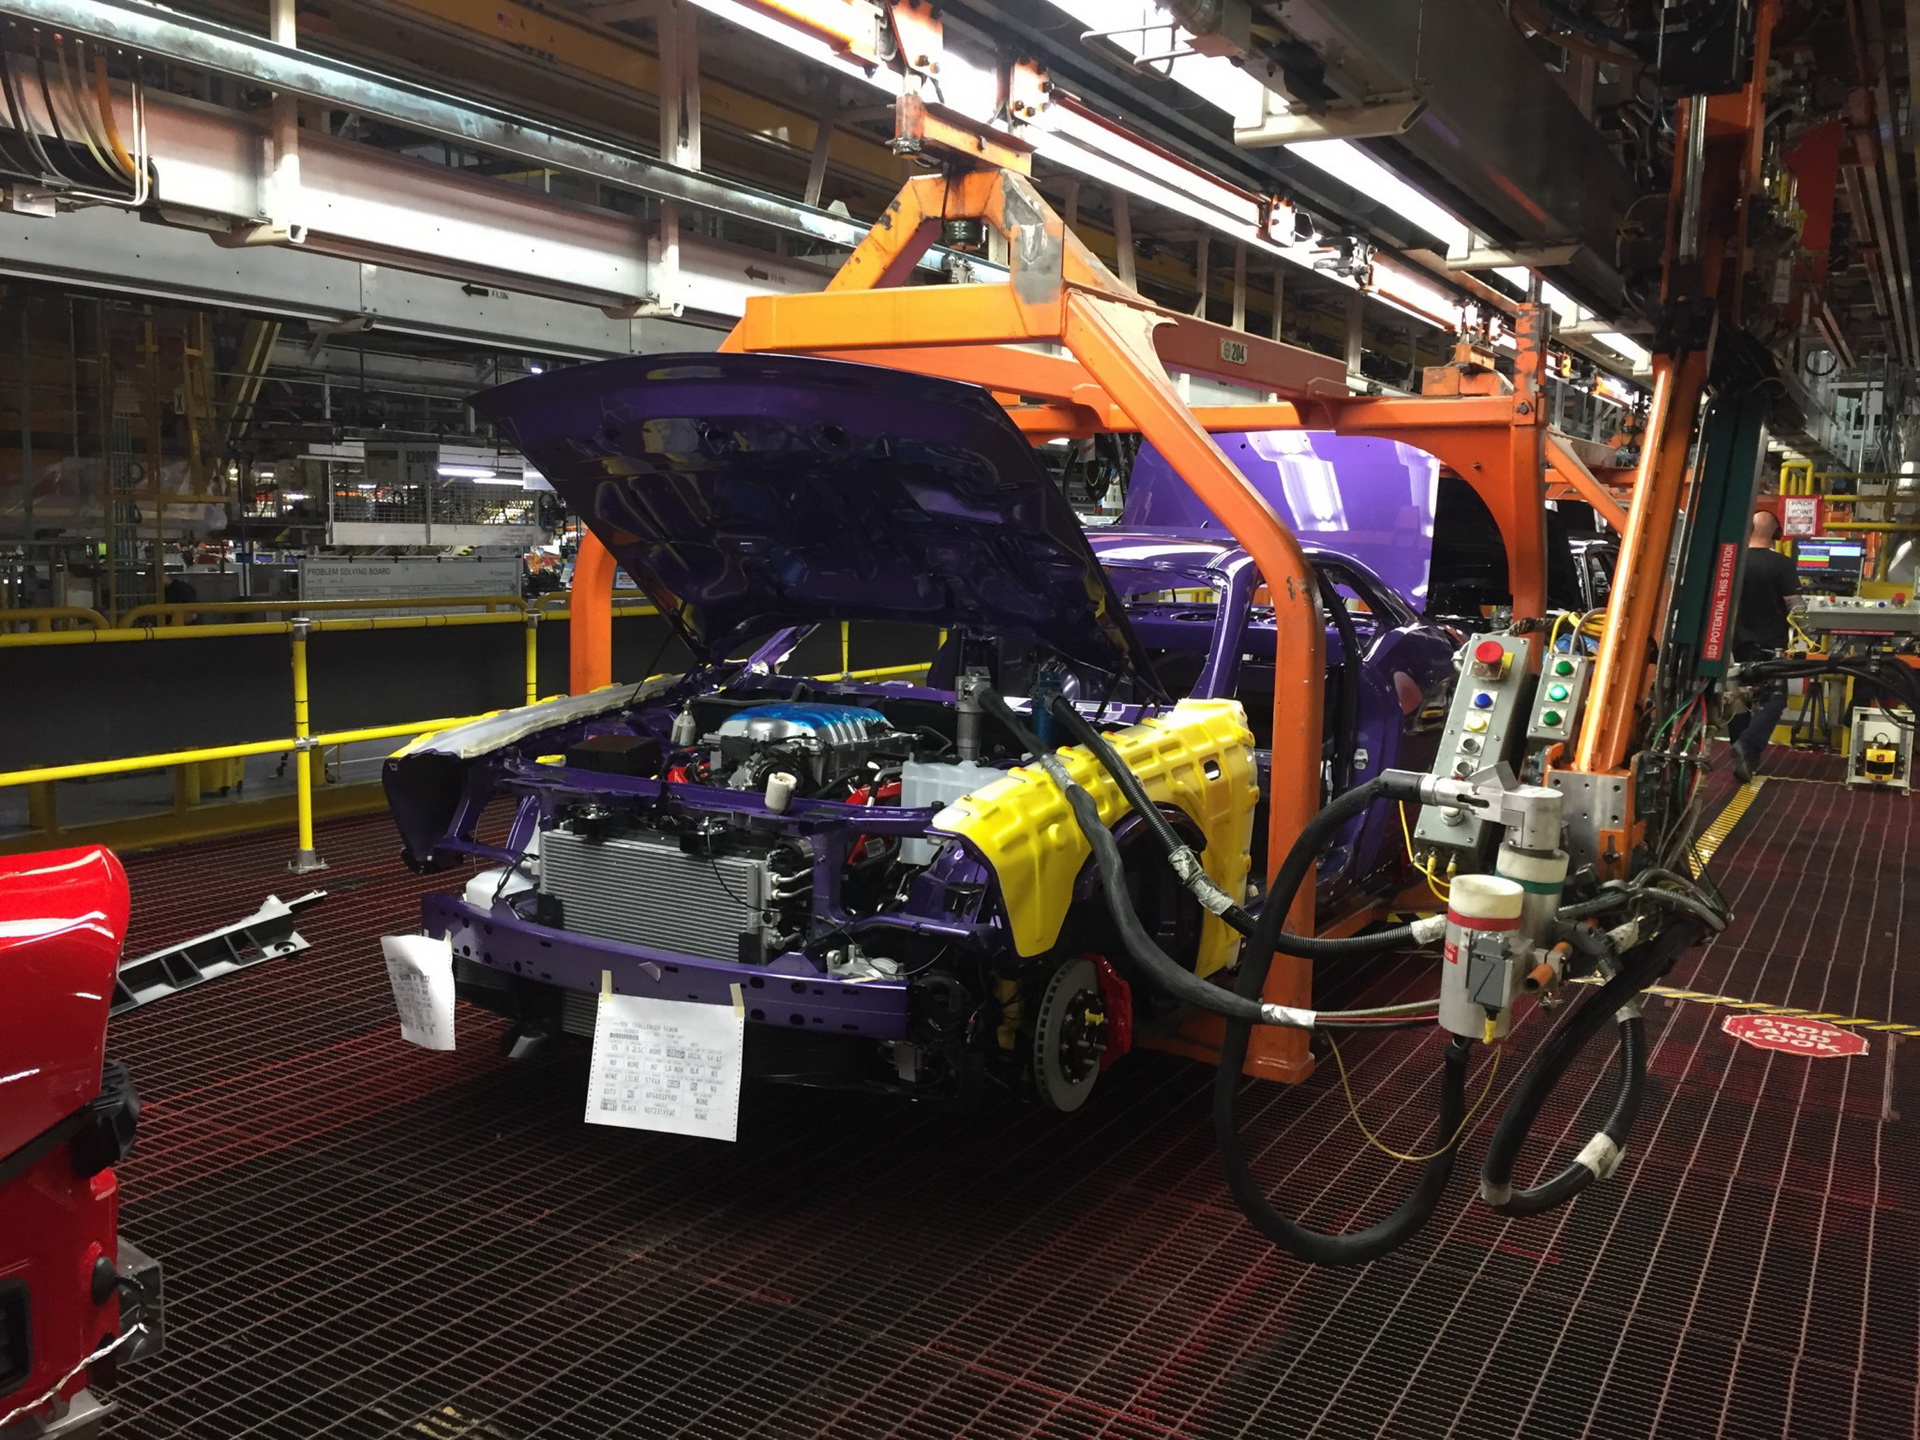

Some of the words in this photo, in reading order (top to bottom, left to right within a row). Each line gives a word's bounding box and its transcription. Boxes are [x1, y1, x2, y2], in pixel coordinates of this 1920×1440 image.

[1232, 343, 1244, 362] 204
[1720, 544, 1734, 578] STATION
[307, 567, 339, 576] PROBLEM
[340, 567, 368, 576] SOLVING
[369, 567, 391, 575] BOARD
[1717, 579, 1729, 597] THIS
[1710, 598, 1726, 644] POTENTIAL
[1753, 1018, 1842, 1037] STOP
[1758, 1027, 1831, 1044] AND
[1744, 1030, 1841, 1053] LOOK
